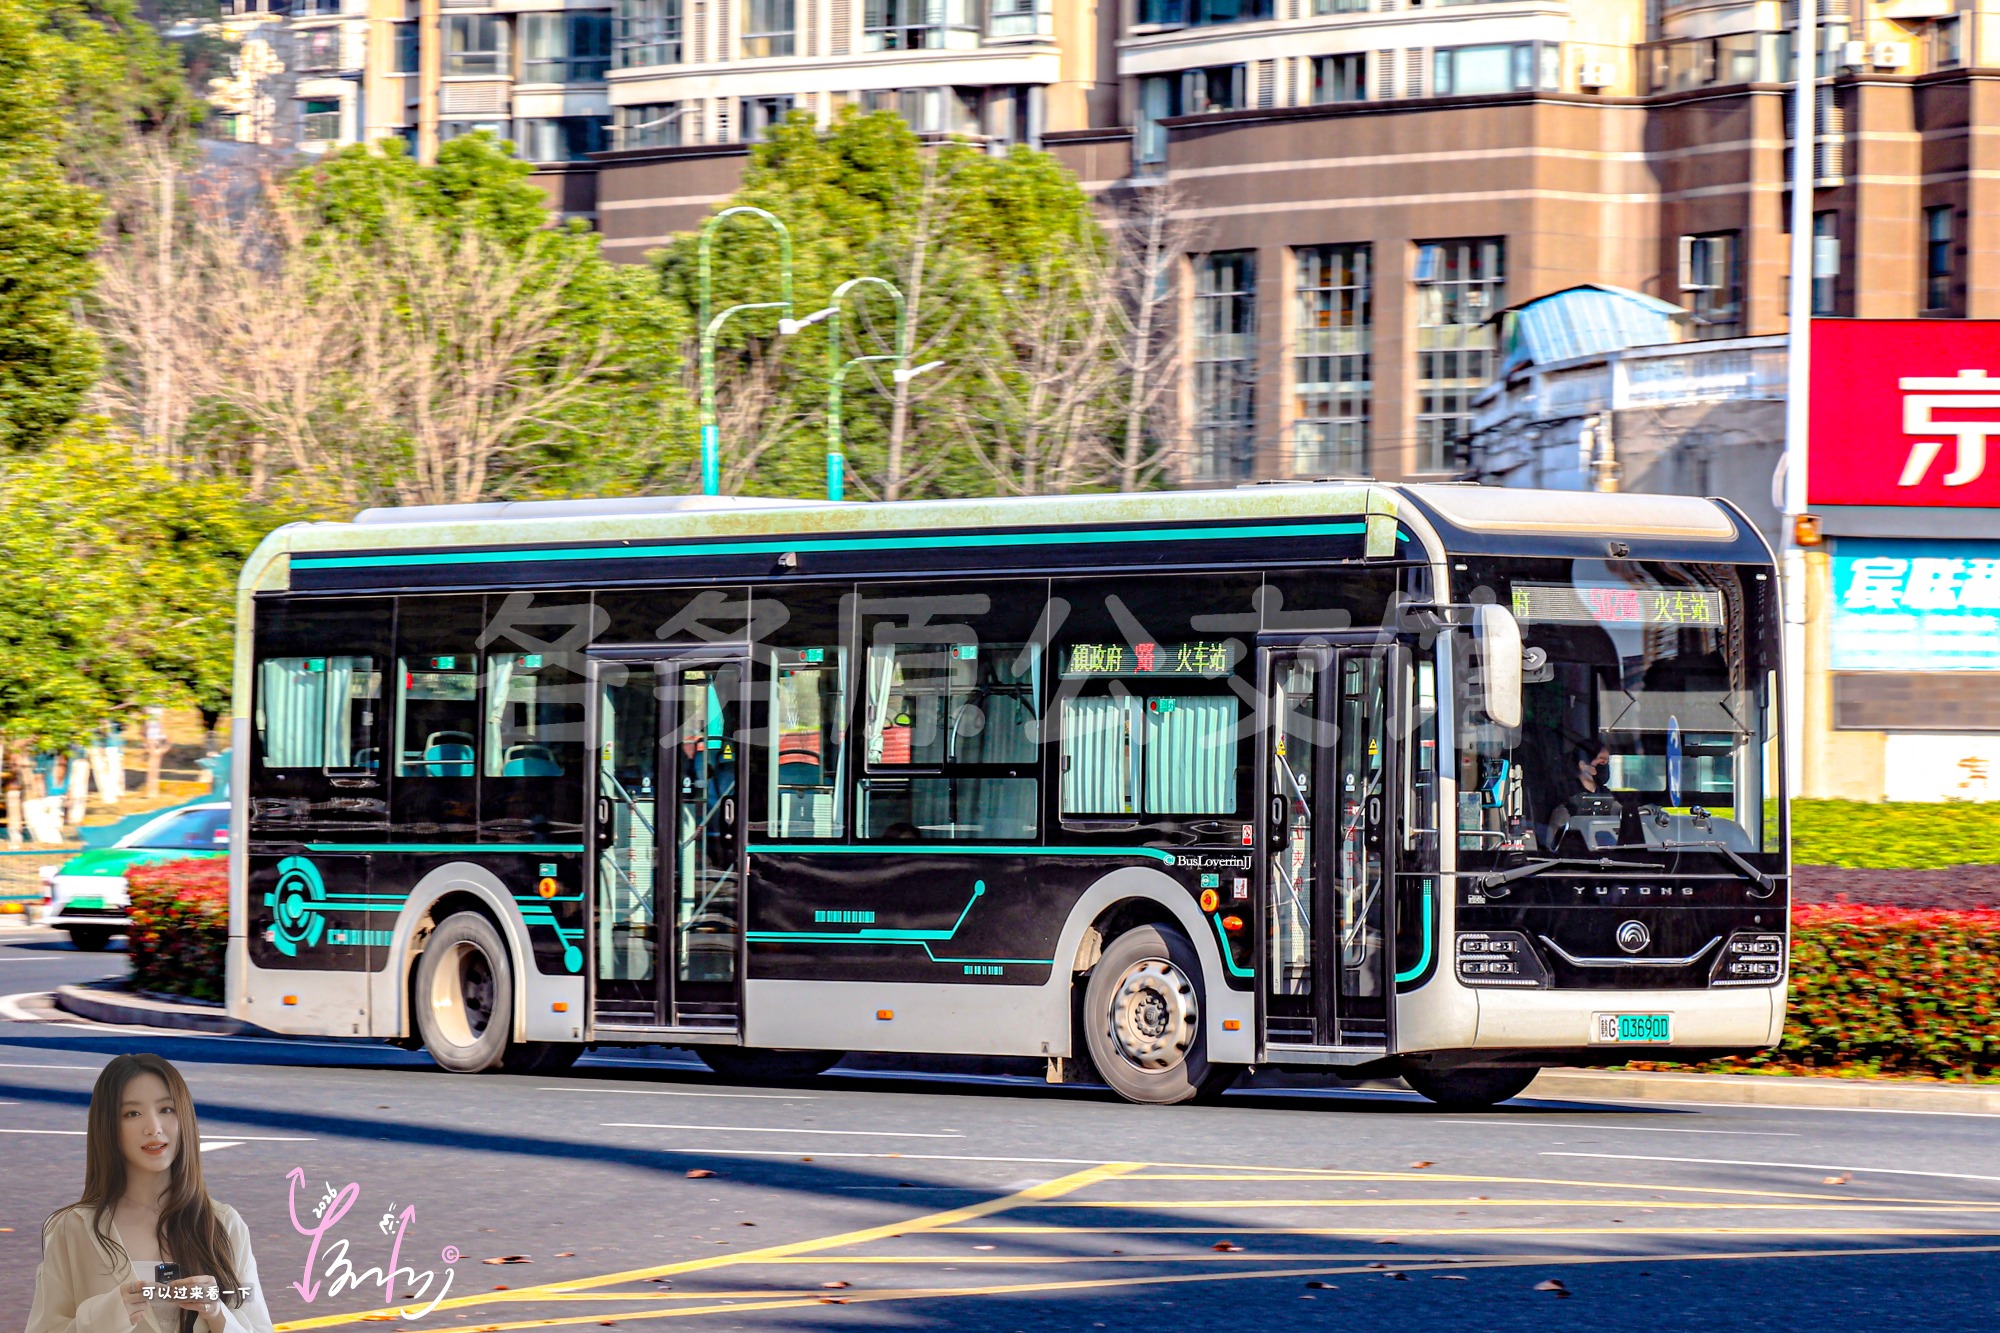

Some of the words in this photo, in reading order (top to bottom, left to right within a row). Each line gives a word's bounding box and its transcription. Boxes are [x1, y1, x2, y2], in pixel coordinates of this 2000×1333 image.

[1898, 369, 2000, 486] 京
[1654, 591, 1709, 623] 火车站
[1175, 641, 1227, 673] 火车站
[1573, 885, 1694, 896] YUTONG
